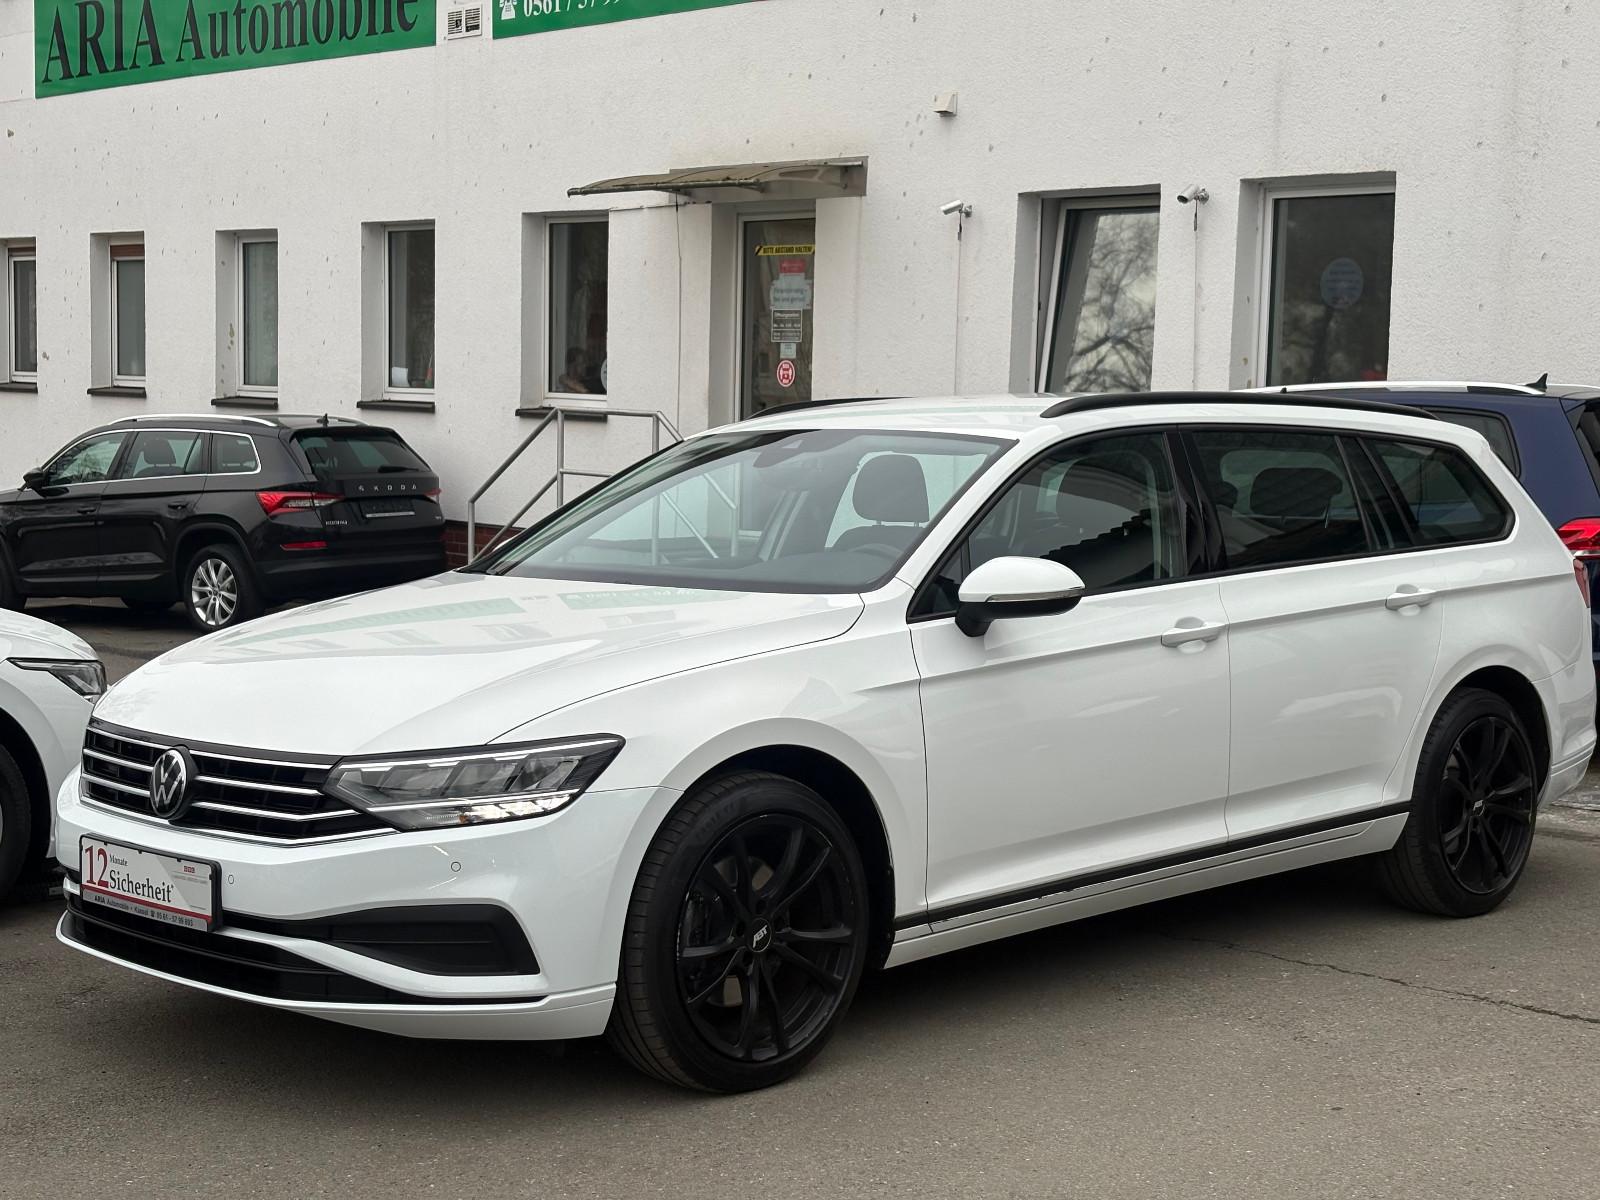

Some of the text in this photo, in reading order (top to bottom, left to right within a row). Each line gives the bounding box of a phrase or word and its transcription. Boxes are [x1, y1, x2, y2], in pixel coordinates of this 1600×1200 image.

[41, 0, 165, 83] ARIA
[85, 845, 109, 889] 12
[109, 853, 128, 867] Monate
